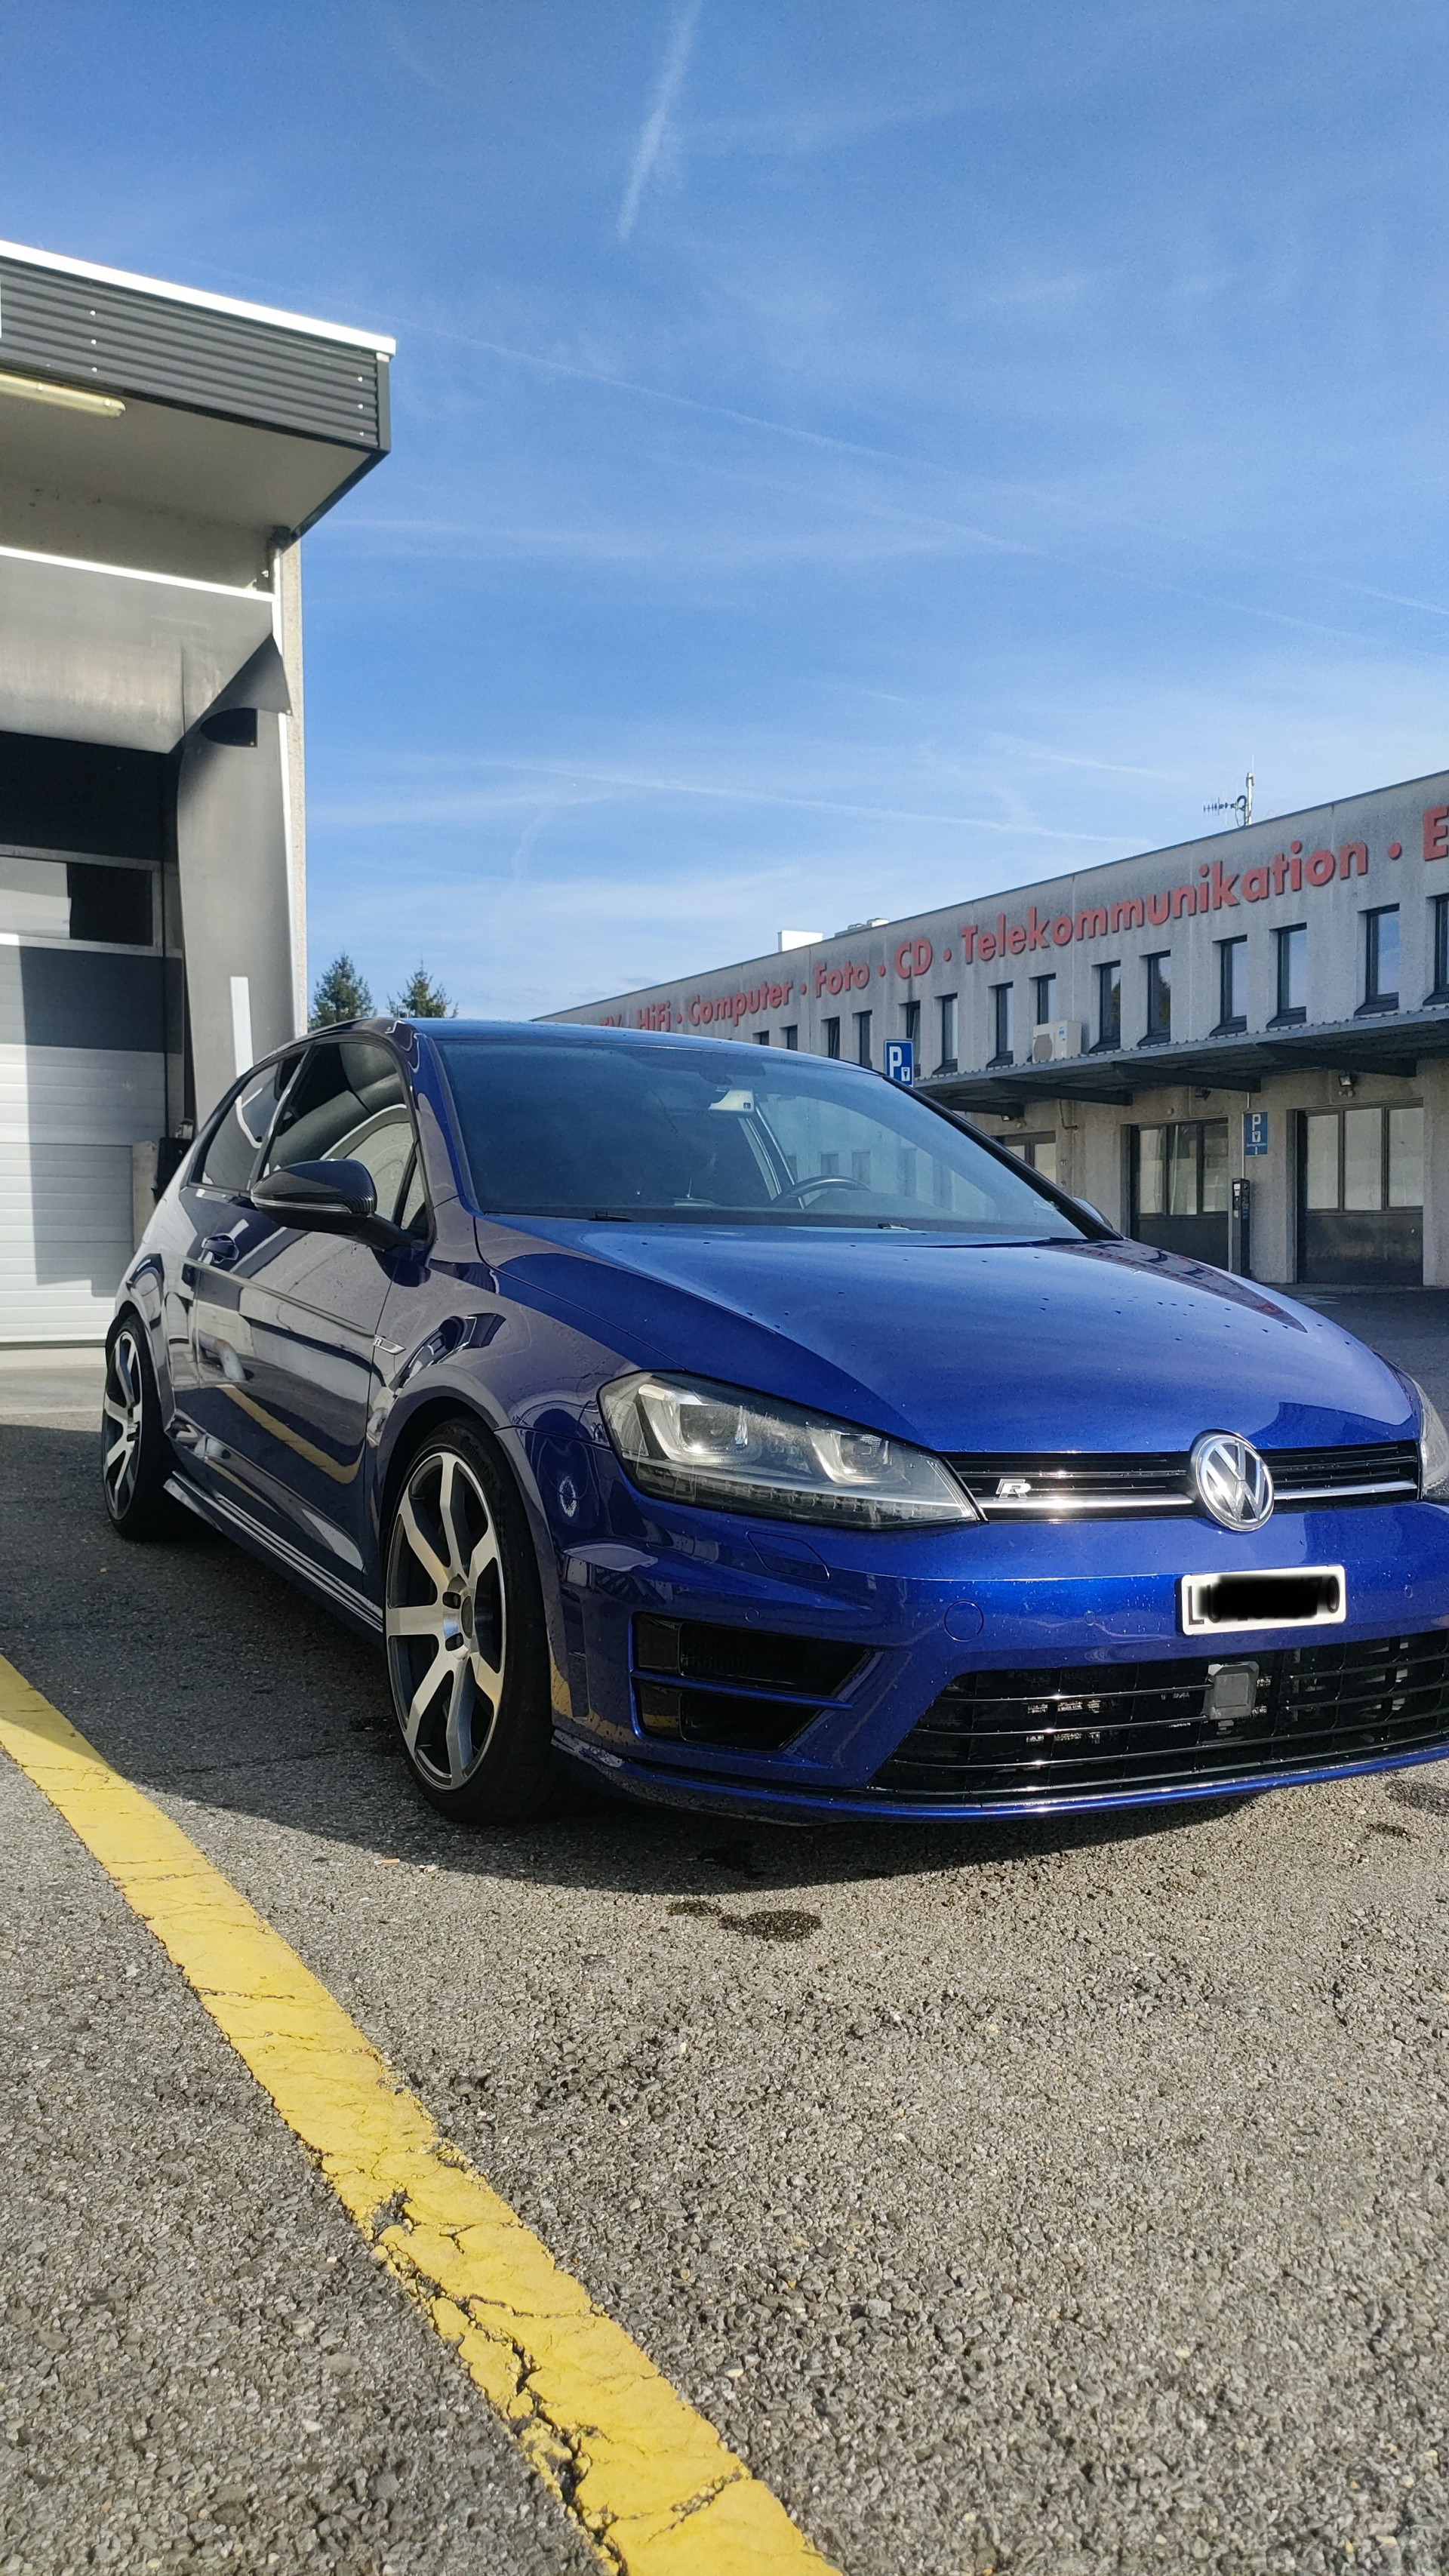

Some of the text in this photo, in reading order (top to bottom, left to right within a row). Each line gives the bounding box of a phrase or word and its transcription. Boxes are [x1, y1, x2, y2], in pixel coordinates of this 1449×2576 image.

[636, 1000, 670, 1032] HiFi
[688, 981, 793, 1026] Computer
[814, 959, 869, 998] Foto
[894, 938, 932, 979] CD
[961, 840, 1367, 965] Telekommunikation
[889, 1046, 902, 1078] P
[1252, 1113, 1261, 1131] P
[995, 1479, 1031, 1498] R
